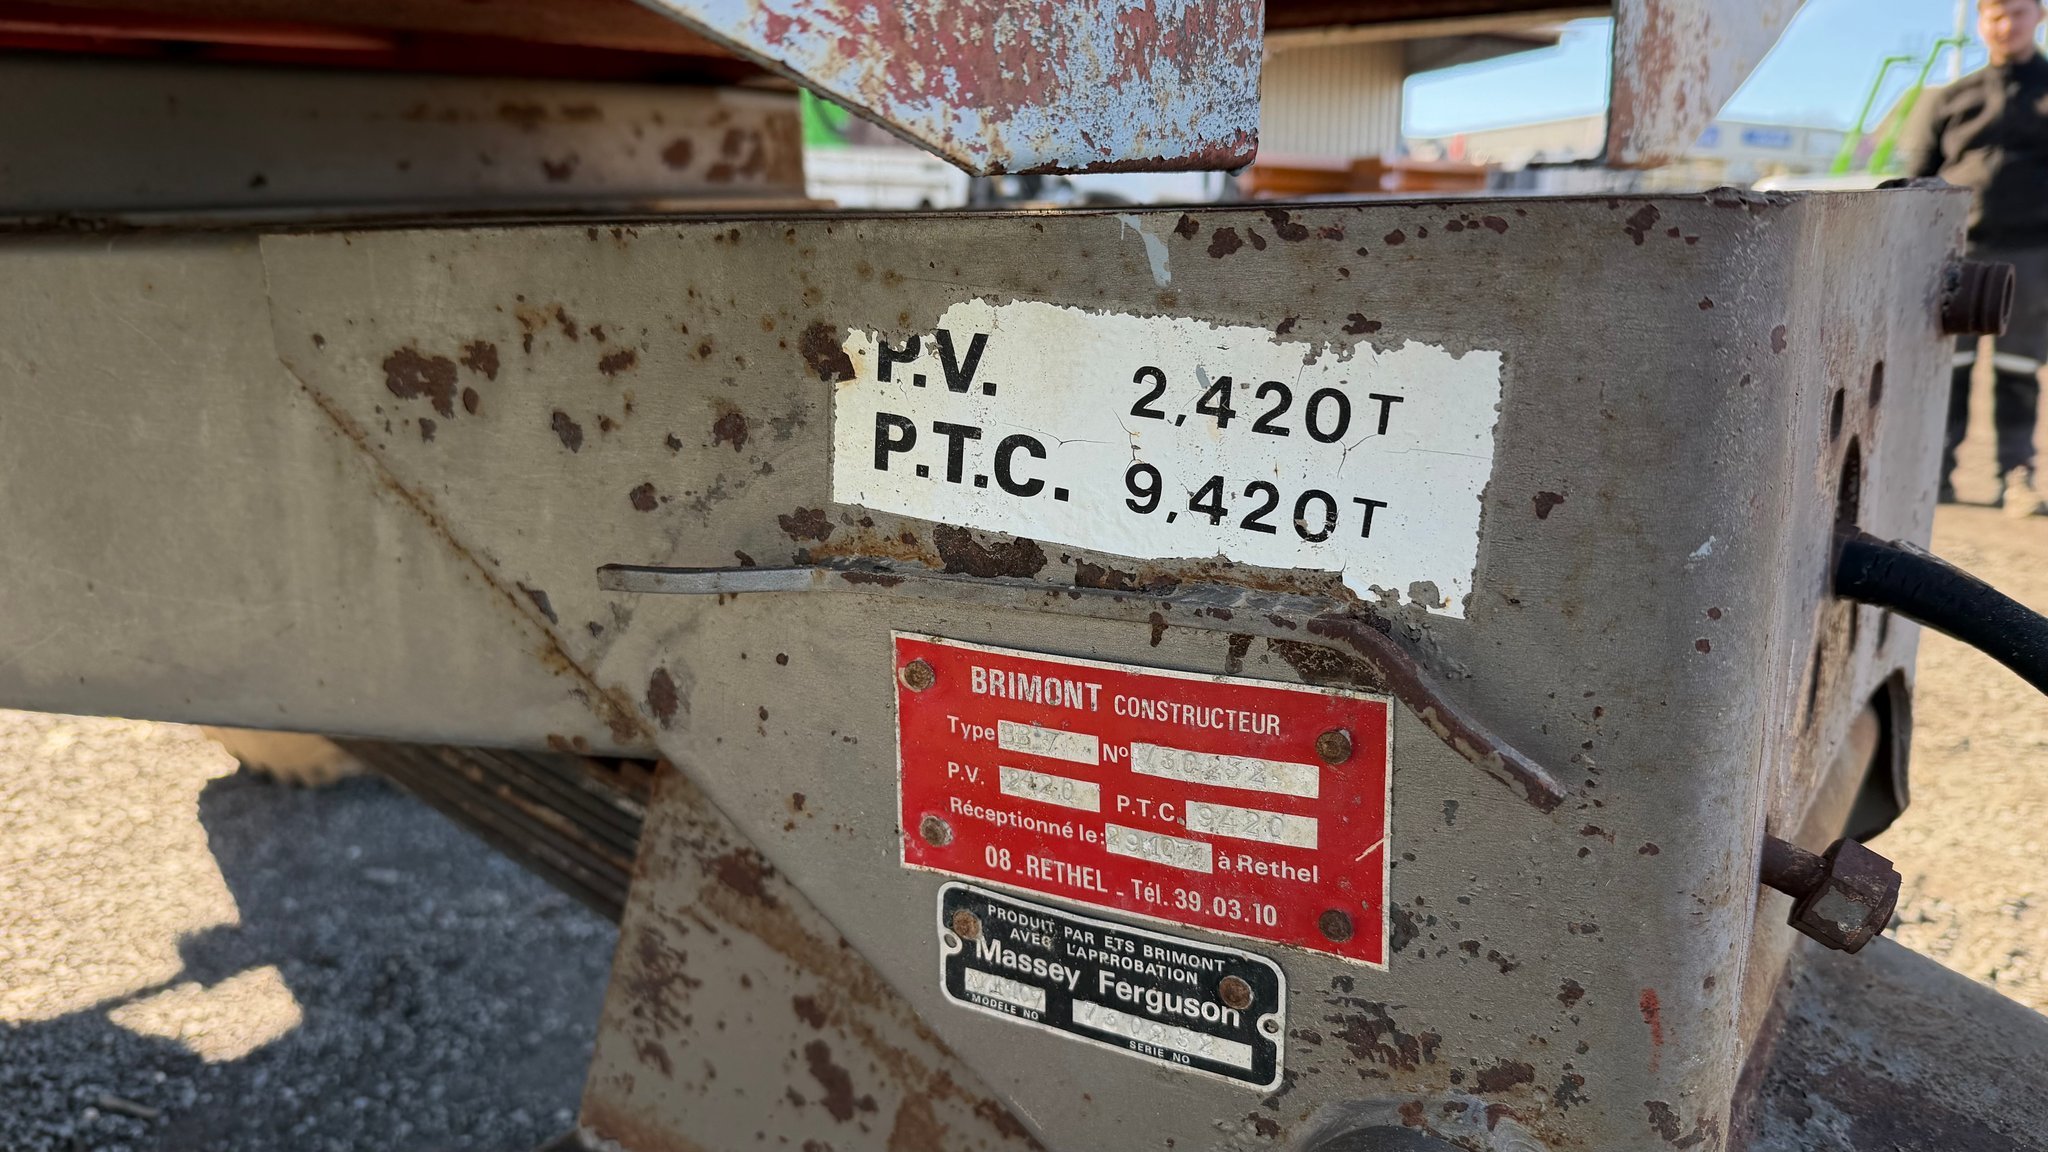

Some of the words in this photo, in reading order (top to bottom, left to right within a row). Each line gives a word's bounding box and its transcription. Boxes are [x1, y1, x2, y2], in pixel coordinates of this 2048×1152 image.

[877, 328, 997, 396] P.V.
[1131, 365, 1351, 443] 2,420
[1369, 392, 1404, 435] T
[874, 412, 1070, 502] P.T.C.
[1124, 463, 1338, 543] 9,420
[1353, 497, 1387, 538] T
[947, 715, 995, 741] Type
[971, 665, 1102, 712] BRIMONT
[1114, 694, 1281, 736] CONSTRUCTEUR
[947, 761, 985, 785] P.V.
[1117, 795, 1185, 825] P.T.C.
[950, 796, 1073, 838] Réceptionné
[1079, 823, 1105, 845] le:
[1218, 852, 1231, 871] à
[1238, 855, 1318, 884] Rethel
[985, 845, 1012, 872] 08
[1026, 855, 1108, 893] RETHEL
[1131, 878, 1168, 907] Tél.
[1174, 887, 1278, 928] 39.03.10
[988, 904, 1055, 934] PRODUIT
[1064, 926, 1095, 946] PAR
[1104, 935, 1136, 953] ETS
[1143, 943, 1226, 974] BRIMONT
[1066, 944, 1199, 986] L'APPROBATION
[971, 993, 1017, 1014] MODELE
[1023, 1009, 1039, 1020] NO
[976, 936, 1081, 991] Massey
[1100, 969, 1240, 1027] Ferguson
[1129, 1040, 1165, 1059] SERIE
[1172, 1052, 1191, 1064] NO
